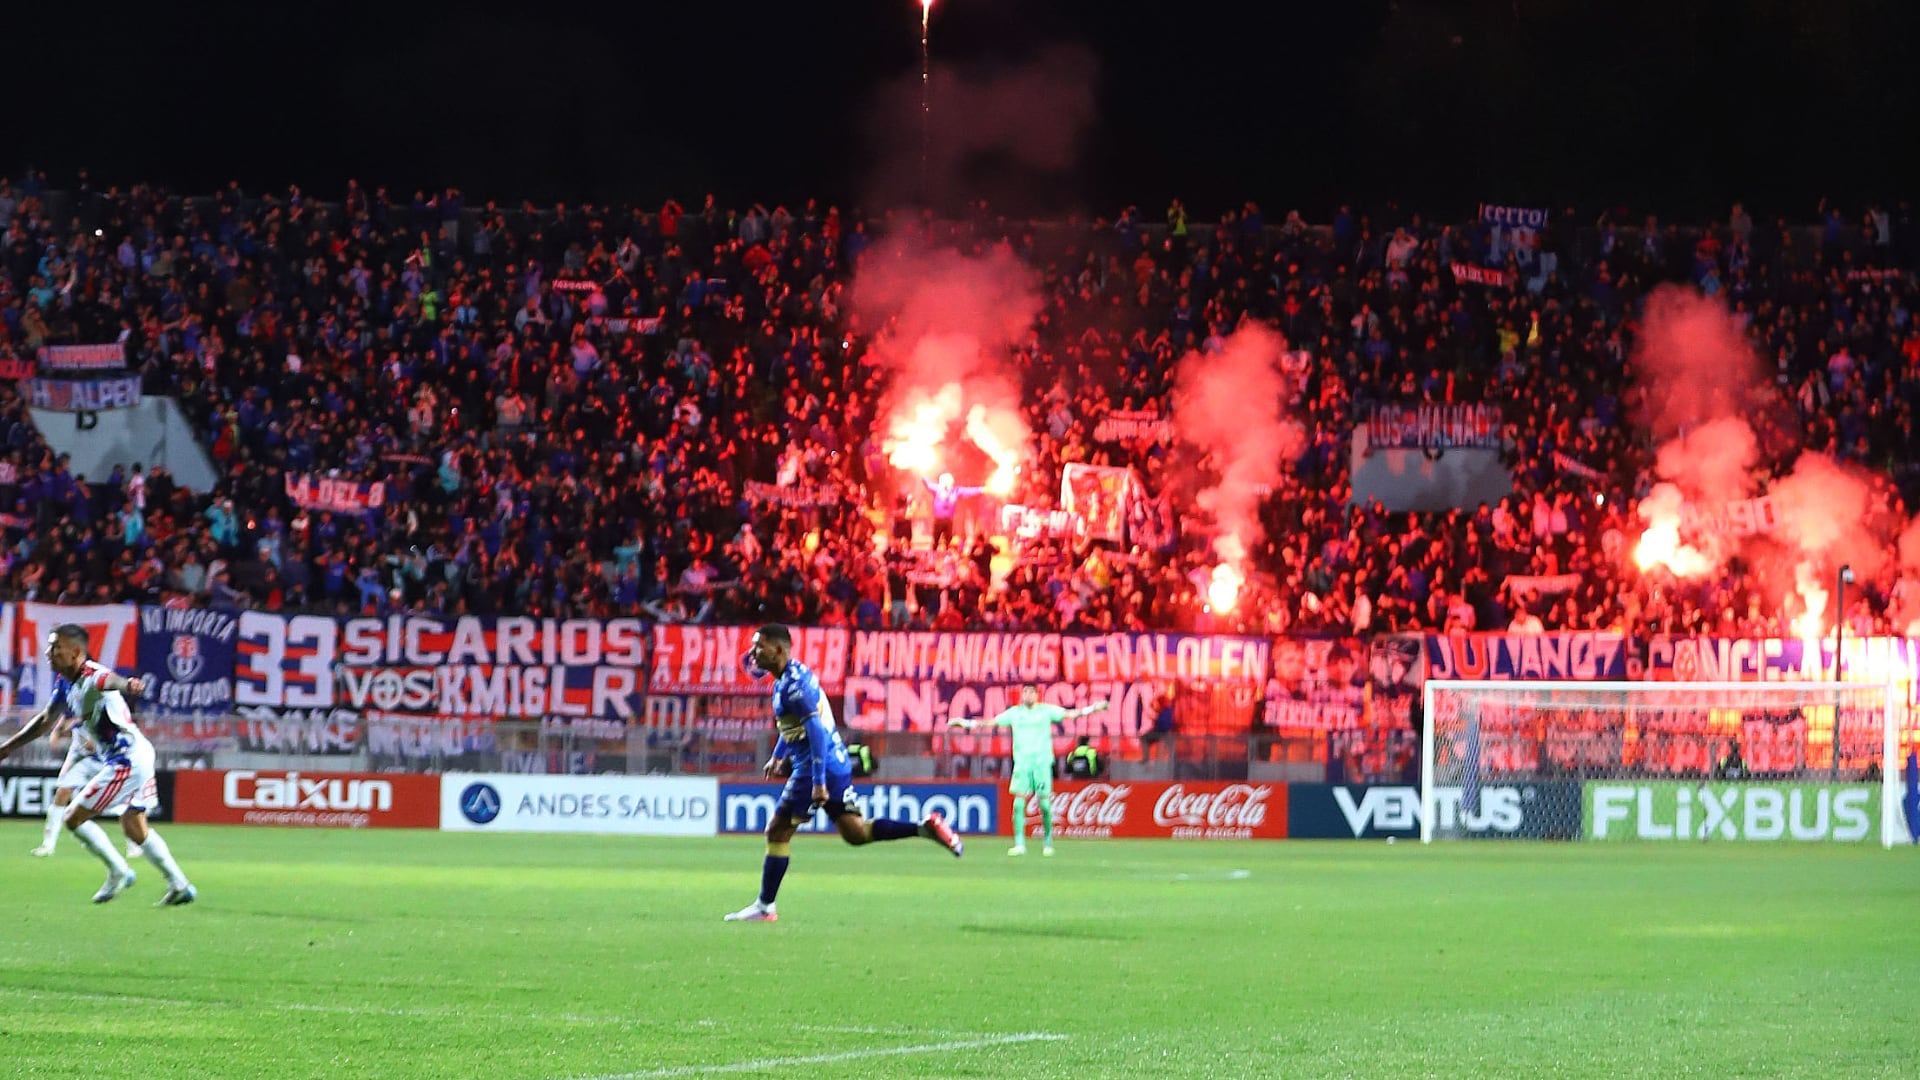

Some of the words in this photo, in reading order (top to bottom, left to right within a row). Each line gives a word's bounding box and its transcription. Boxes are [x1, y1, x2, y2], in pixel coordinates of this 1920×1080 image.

[165, 607, 236, 641] IMPORTA
[344, 615, 642, 666] SICARIOS
[236, 610, 338, 708] 33
[853, 631, 1061, 681] MONTANIAKOS
[159, 677, 232, 707] ESTADIO
[223, 769, 392, 812] Caixun
[517, 793, 609, 818] ANDES
[618, 795, 710, 820] SALUD
